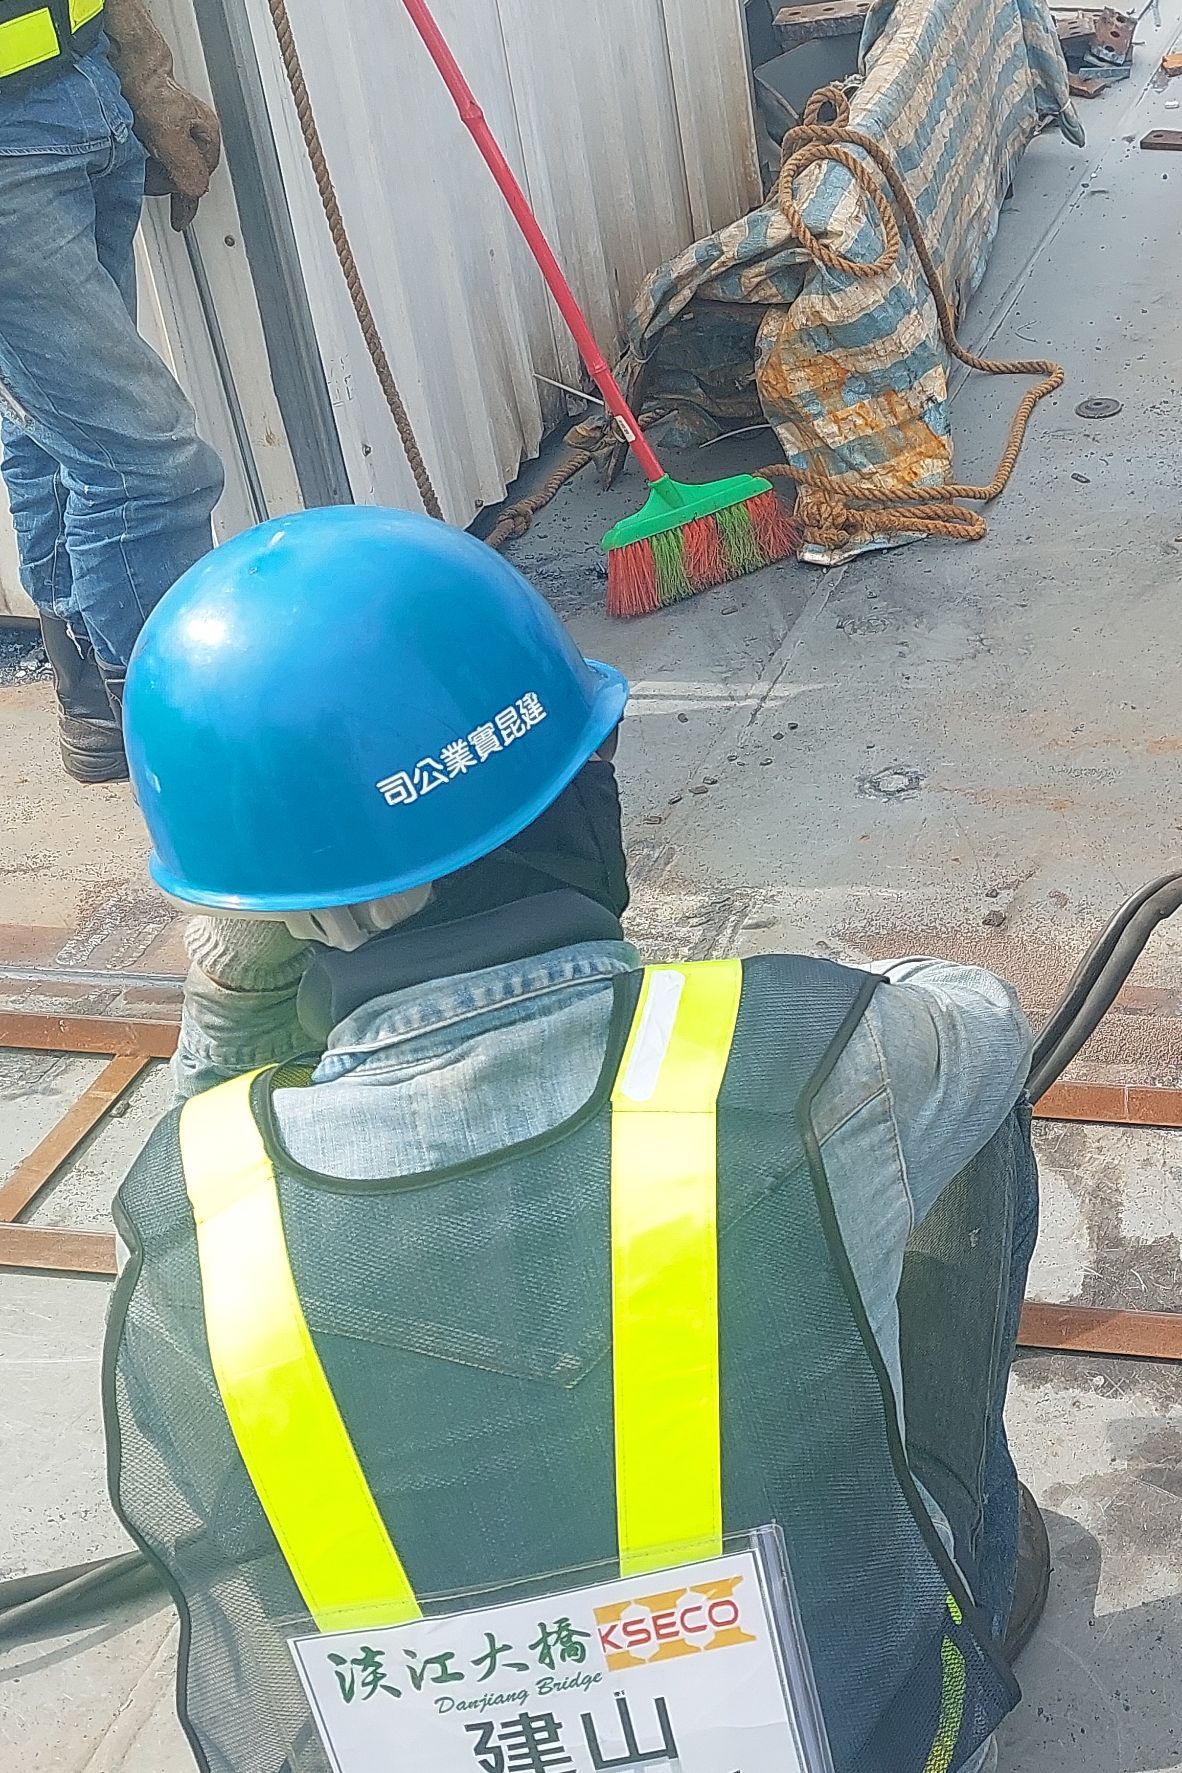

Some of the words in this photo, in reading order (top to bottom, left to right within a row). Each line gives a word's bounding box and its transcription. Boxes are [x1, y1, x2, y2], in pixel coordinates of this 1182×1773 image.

[598, 1599, 739, 1653] KSECO
[327, 1617, 591, 1703] 淡江大橋
[434, 1688, 529, 1714] Danjiang
[535, 1670, 603, 1696] Bridge
